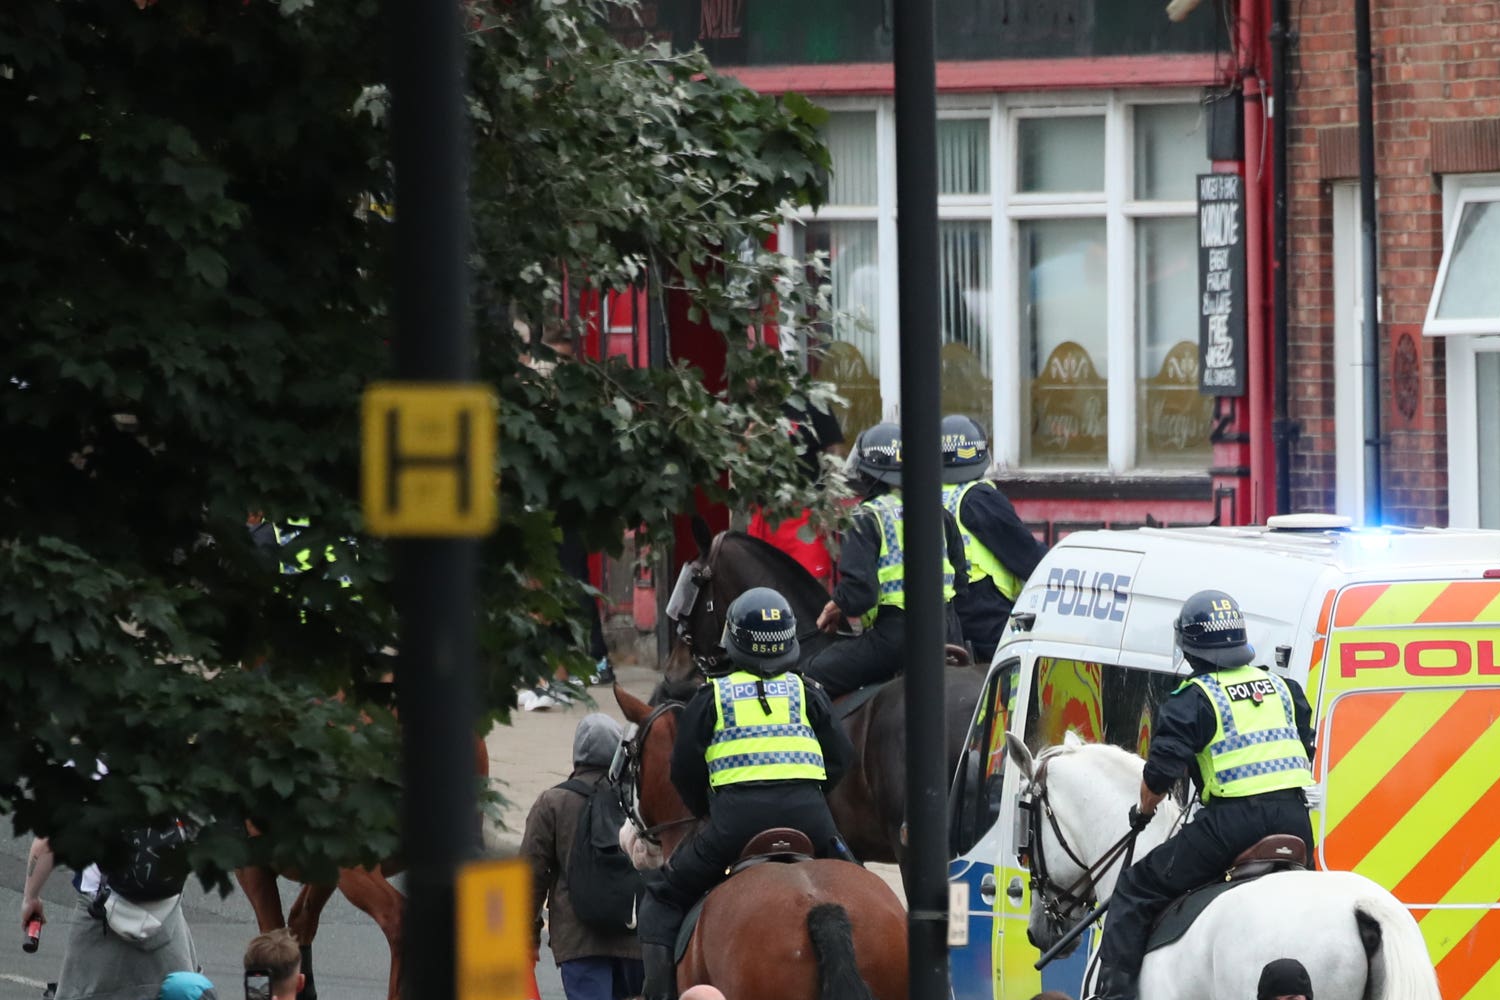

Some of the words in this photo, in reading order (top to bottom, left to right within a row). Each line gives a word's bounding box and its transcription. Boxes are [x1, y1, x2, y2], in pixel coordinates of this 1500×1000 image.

[385, 408, 471, 517] H
[1042, 568, 1131, 622] POLICE
[1212, 600, 1231, 611] LB
[761, 608, 780, 621] LB
